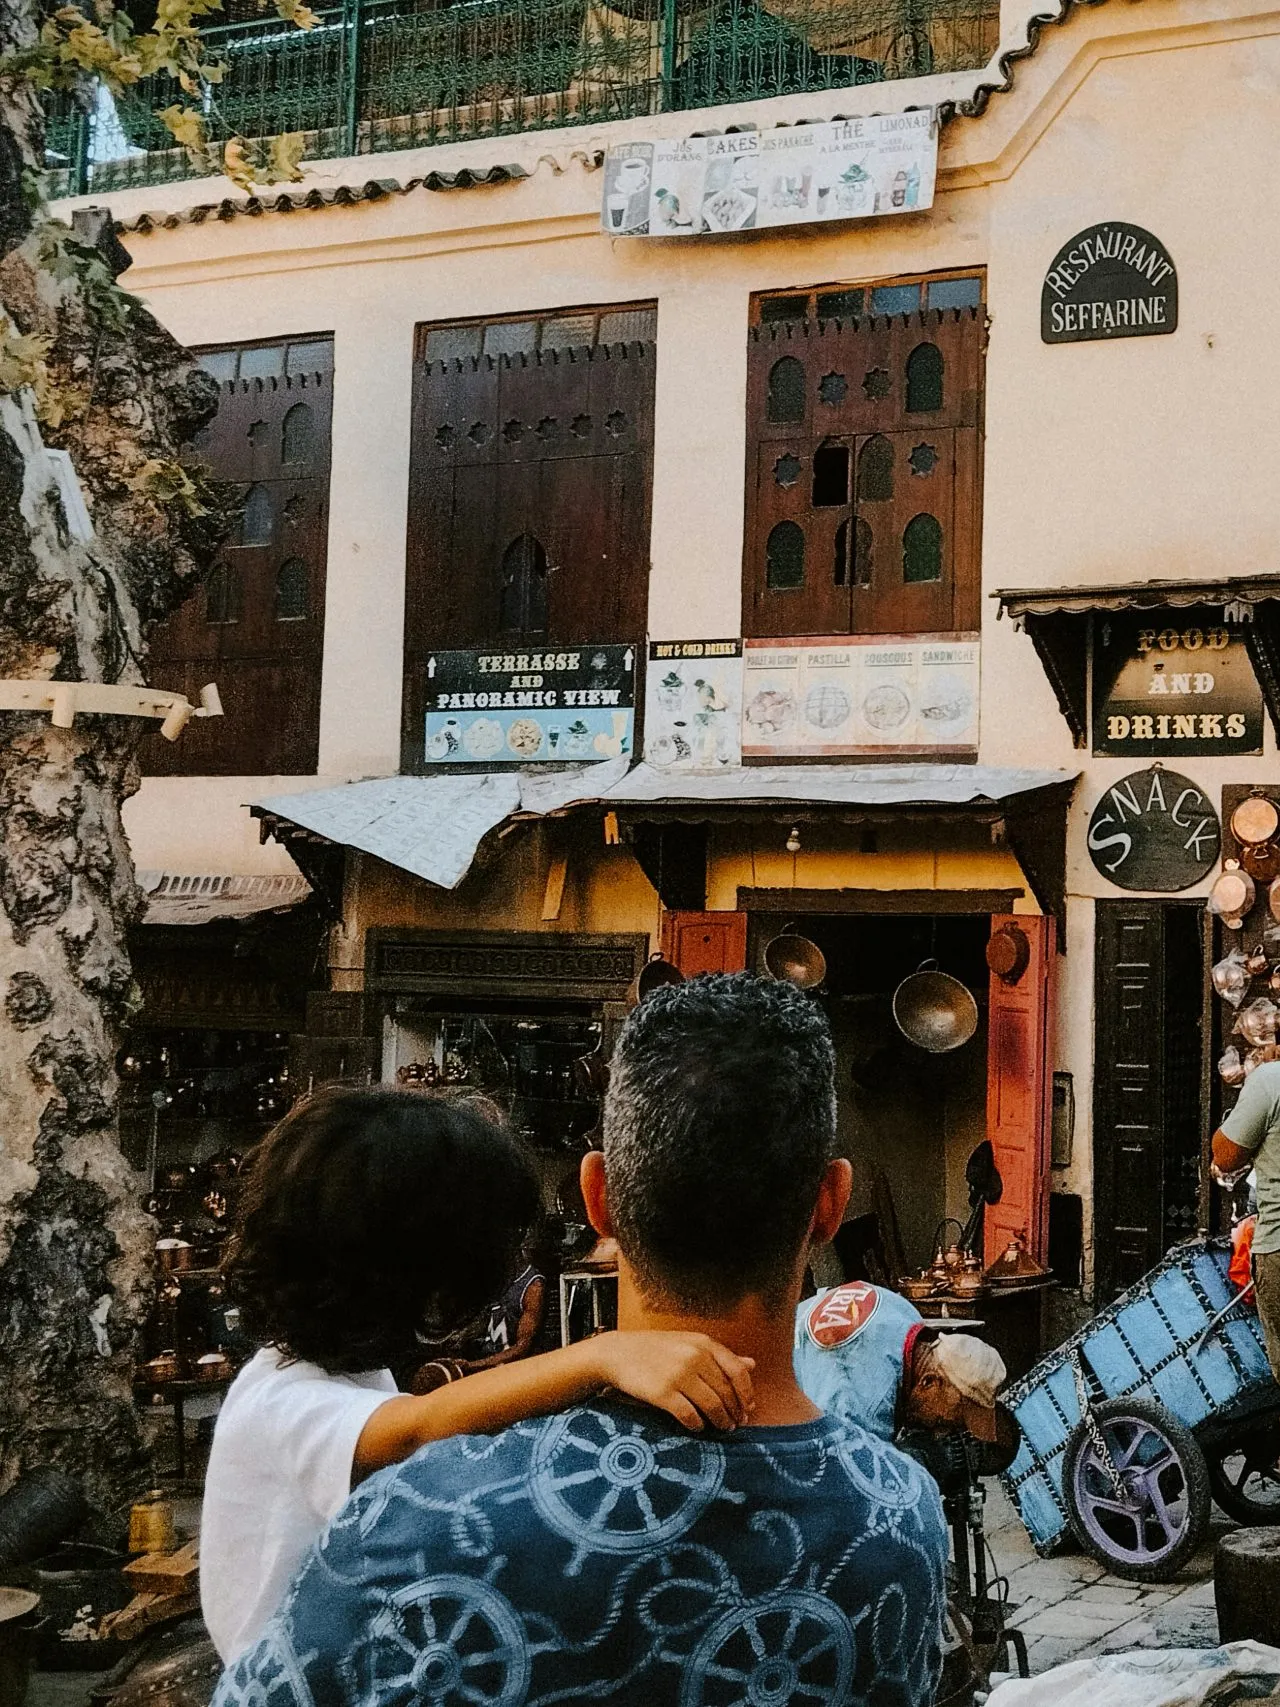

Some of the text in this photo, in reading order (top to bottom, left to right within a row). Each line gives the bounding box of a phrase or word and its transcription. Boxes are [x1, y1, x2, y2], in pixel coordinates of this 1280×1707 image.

[1045, 231, 1174, 298] RESTAURANT
[1051, 296, 1166, 333] SEFFARINE
[656, 644, 673, 657] HOT
[704, 642, 737, 656] DRINKS
[1137, 628, 1230, 652] FOOD
[478, 652, 581, 673] TERRASSE
[807, 652, 850, 665] PASTILLA
[510, 674, 544, 688] AND
[1148, 672, 1215, 695] AND
[437, 689, 622, 709] PANORAMIC VIEW
[1107, 713, 1246, 740] DRINKS
[1088, 773, 1217, 873] SNACK
[813, 1286, 874, 1334] TRIA
